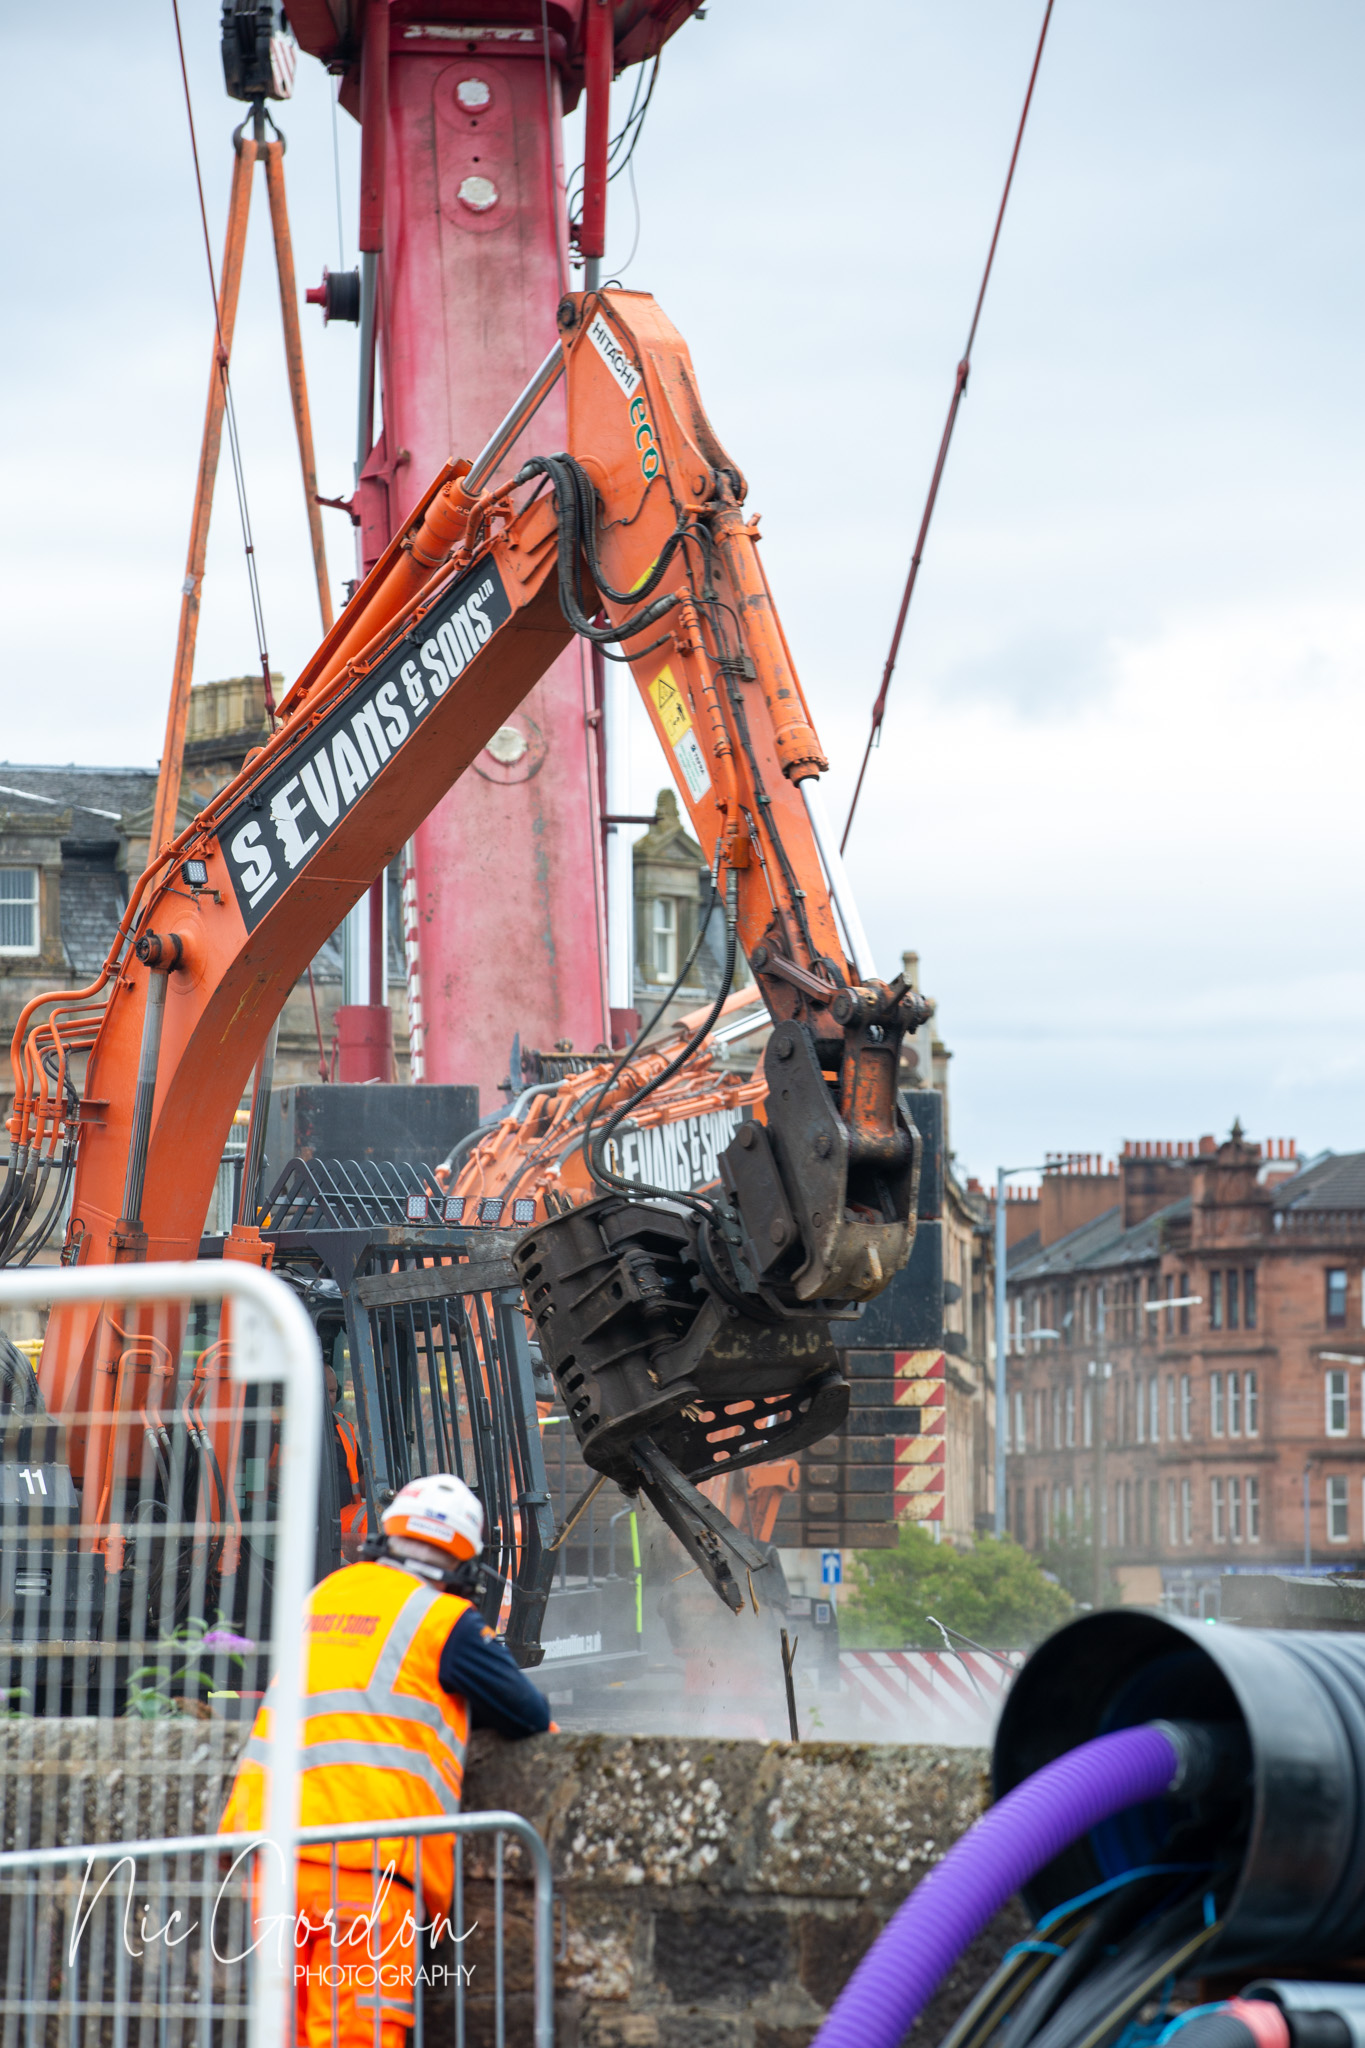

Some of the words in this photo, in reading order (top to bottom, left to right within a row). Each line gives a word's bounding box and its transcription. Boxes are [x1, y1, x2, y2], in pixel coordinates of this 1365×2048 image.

[592, 322, 635, 389] HITACHI
[231, 821, 275, 900] S
[270, 681, 411, 870] EVANS
[400, 660, 429, 717] &
[419, 592, 494, 697] SONS
[622, 1119, 692, 1202] EVANS
[19, 1468, 48, 1495] 11
